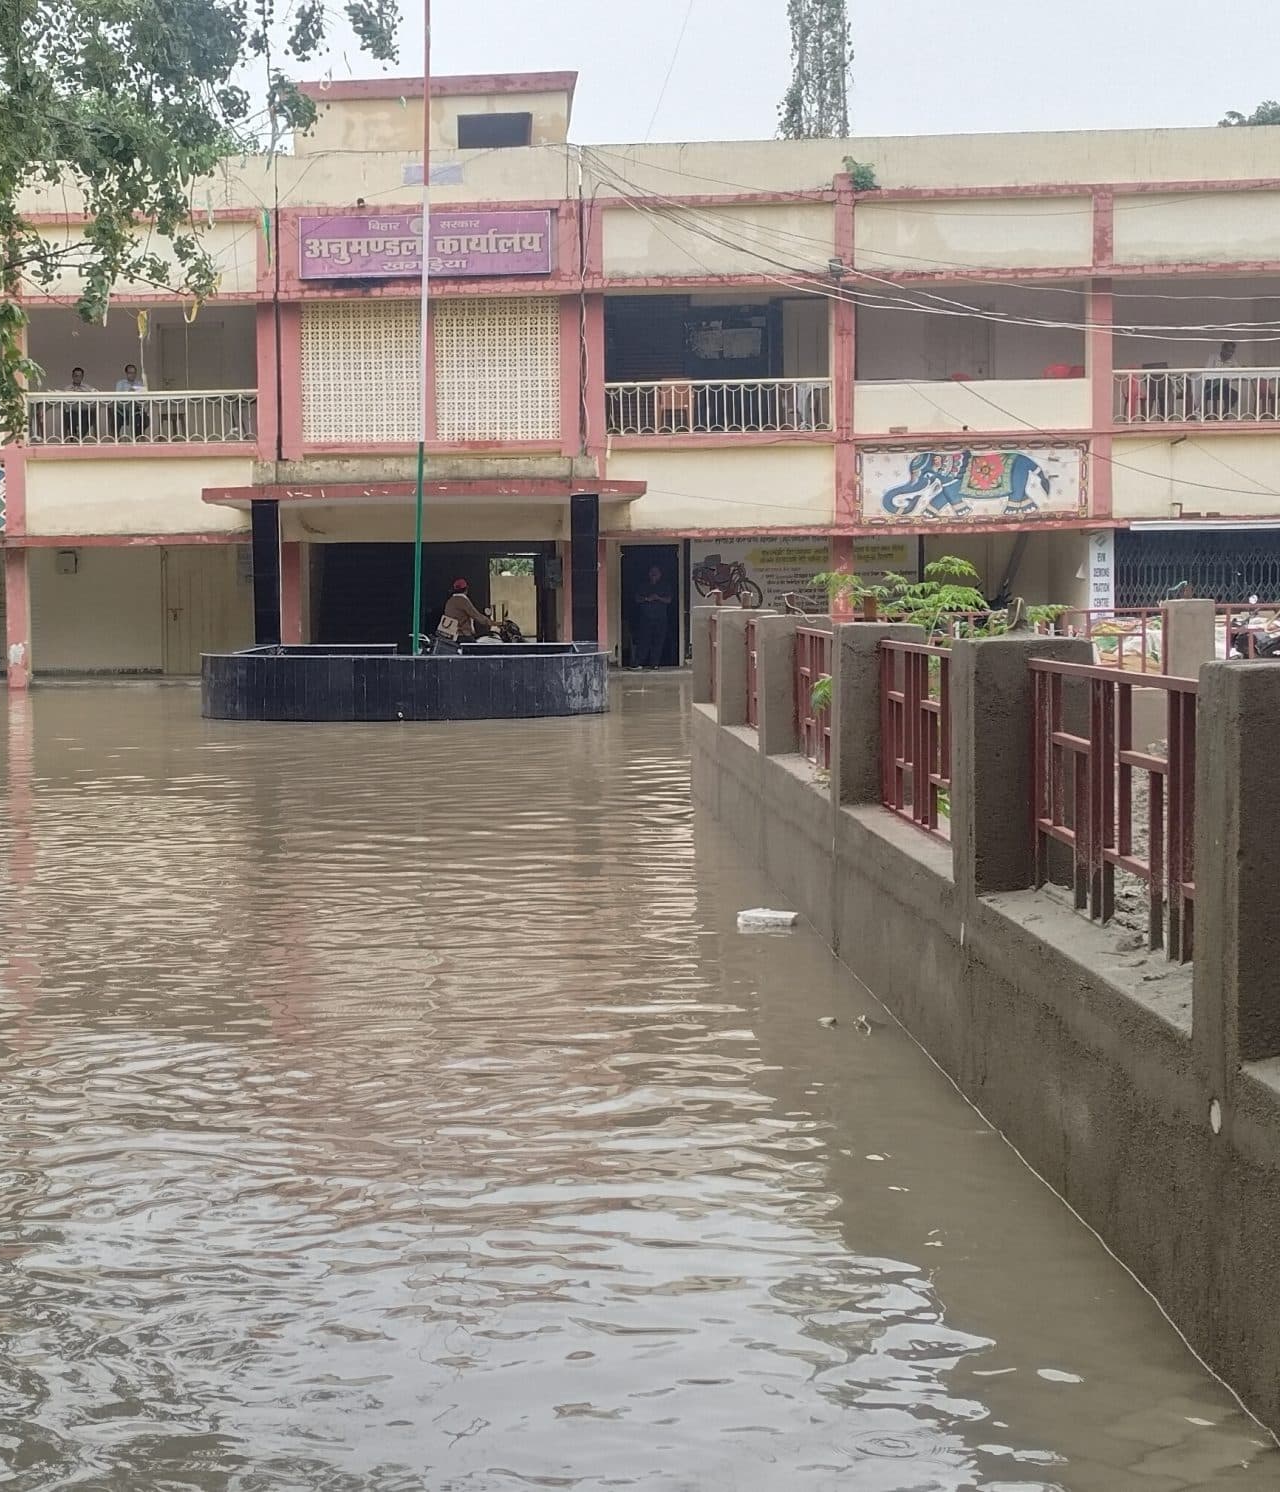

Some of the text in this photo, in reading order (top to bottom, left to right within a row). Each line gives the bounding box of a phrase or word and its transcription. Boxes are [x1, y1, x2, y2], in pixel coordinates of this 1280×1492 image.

[368, 220, 480, 231] बिहार सरकार
[305, 228, 544, 265] अनुमण्डल कार्यालय
